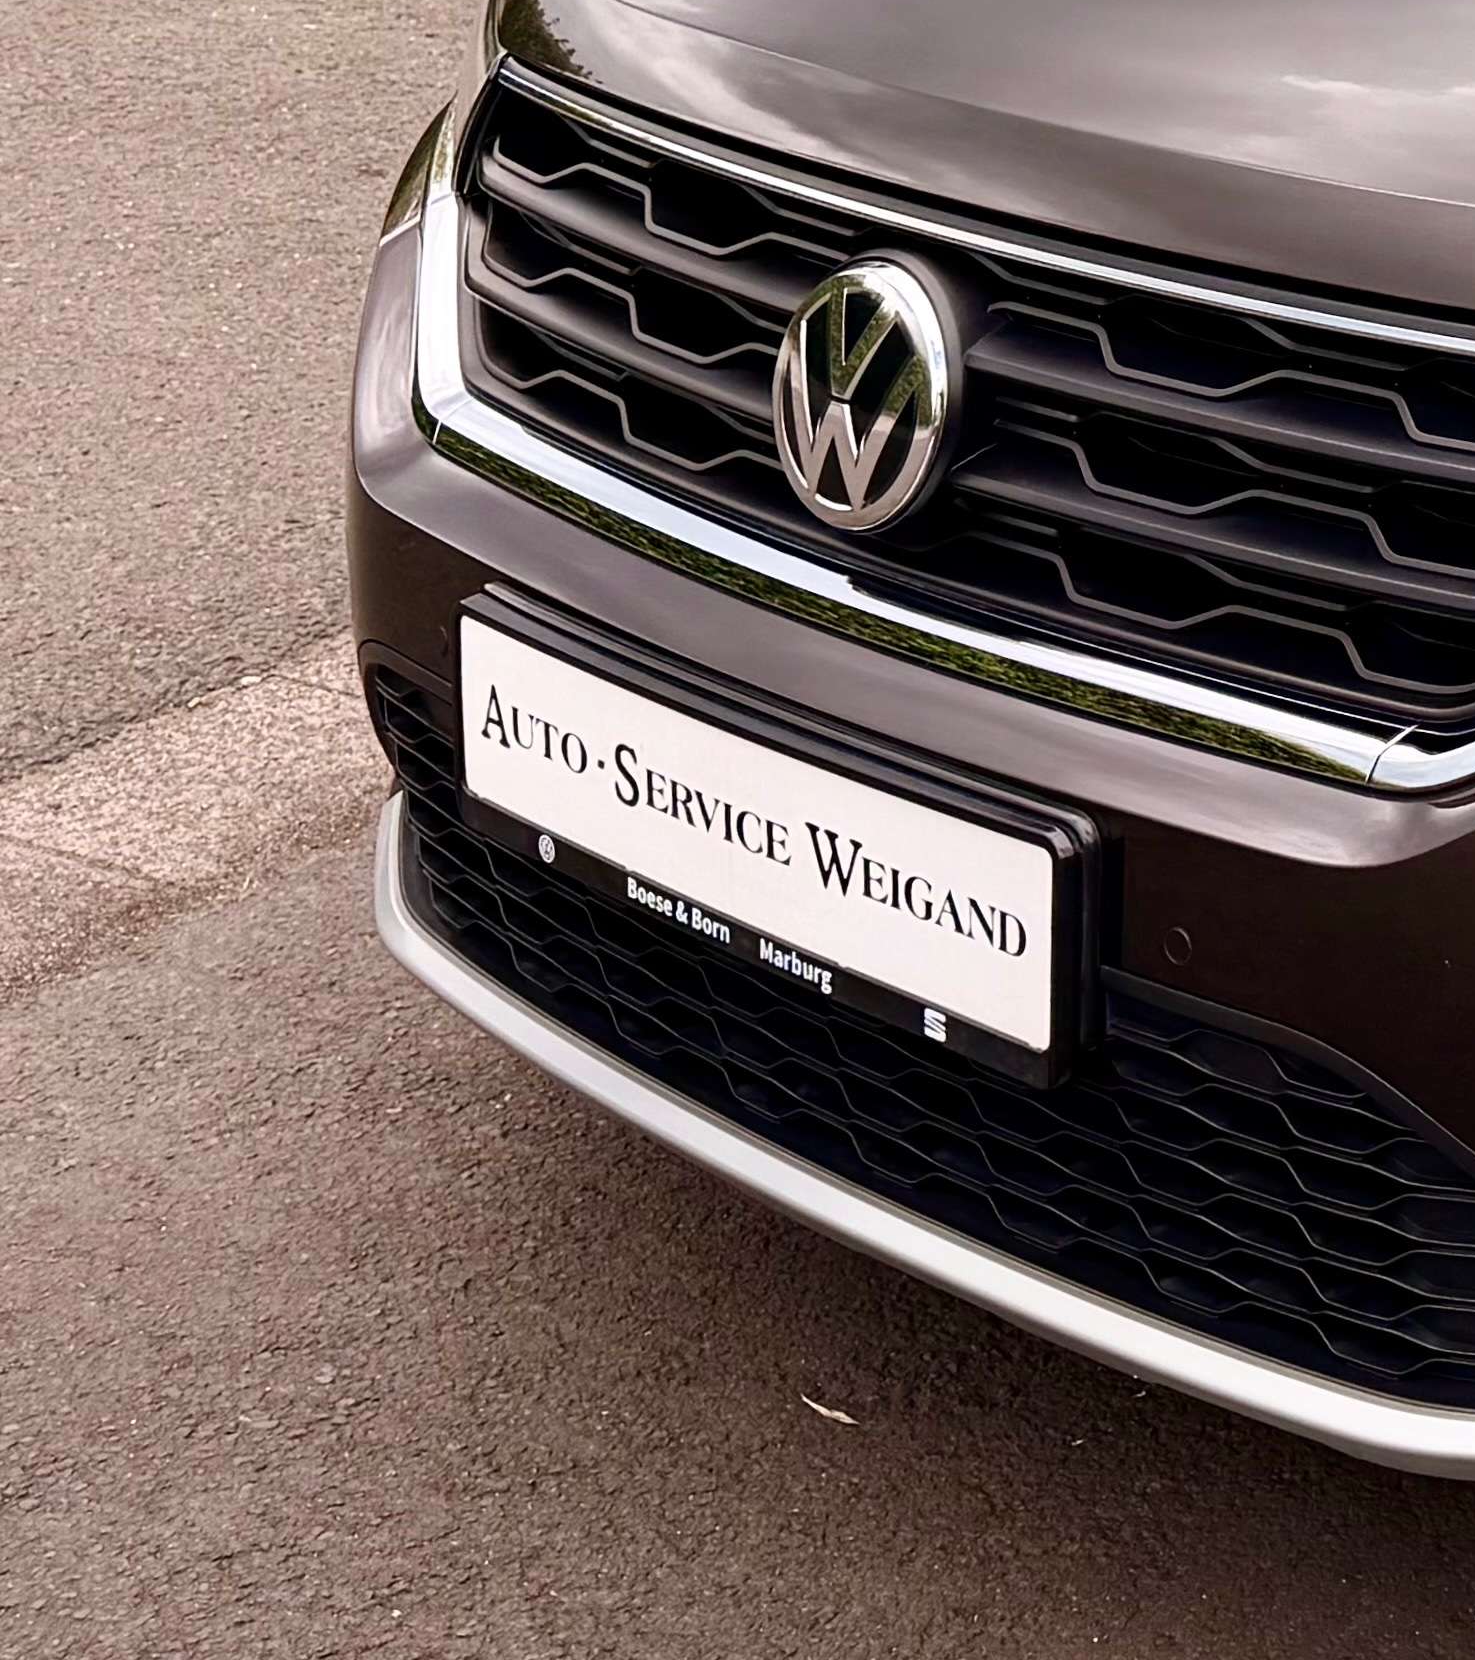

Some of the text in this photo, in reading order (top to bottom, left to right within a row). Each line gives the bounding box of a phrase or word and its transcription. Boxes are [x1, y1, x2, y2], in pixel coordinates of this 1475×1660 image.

[626, 876, 834, 996] Boese & Born Marburg
[803, 821, 1028, 959] WEIGAND
